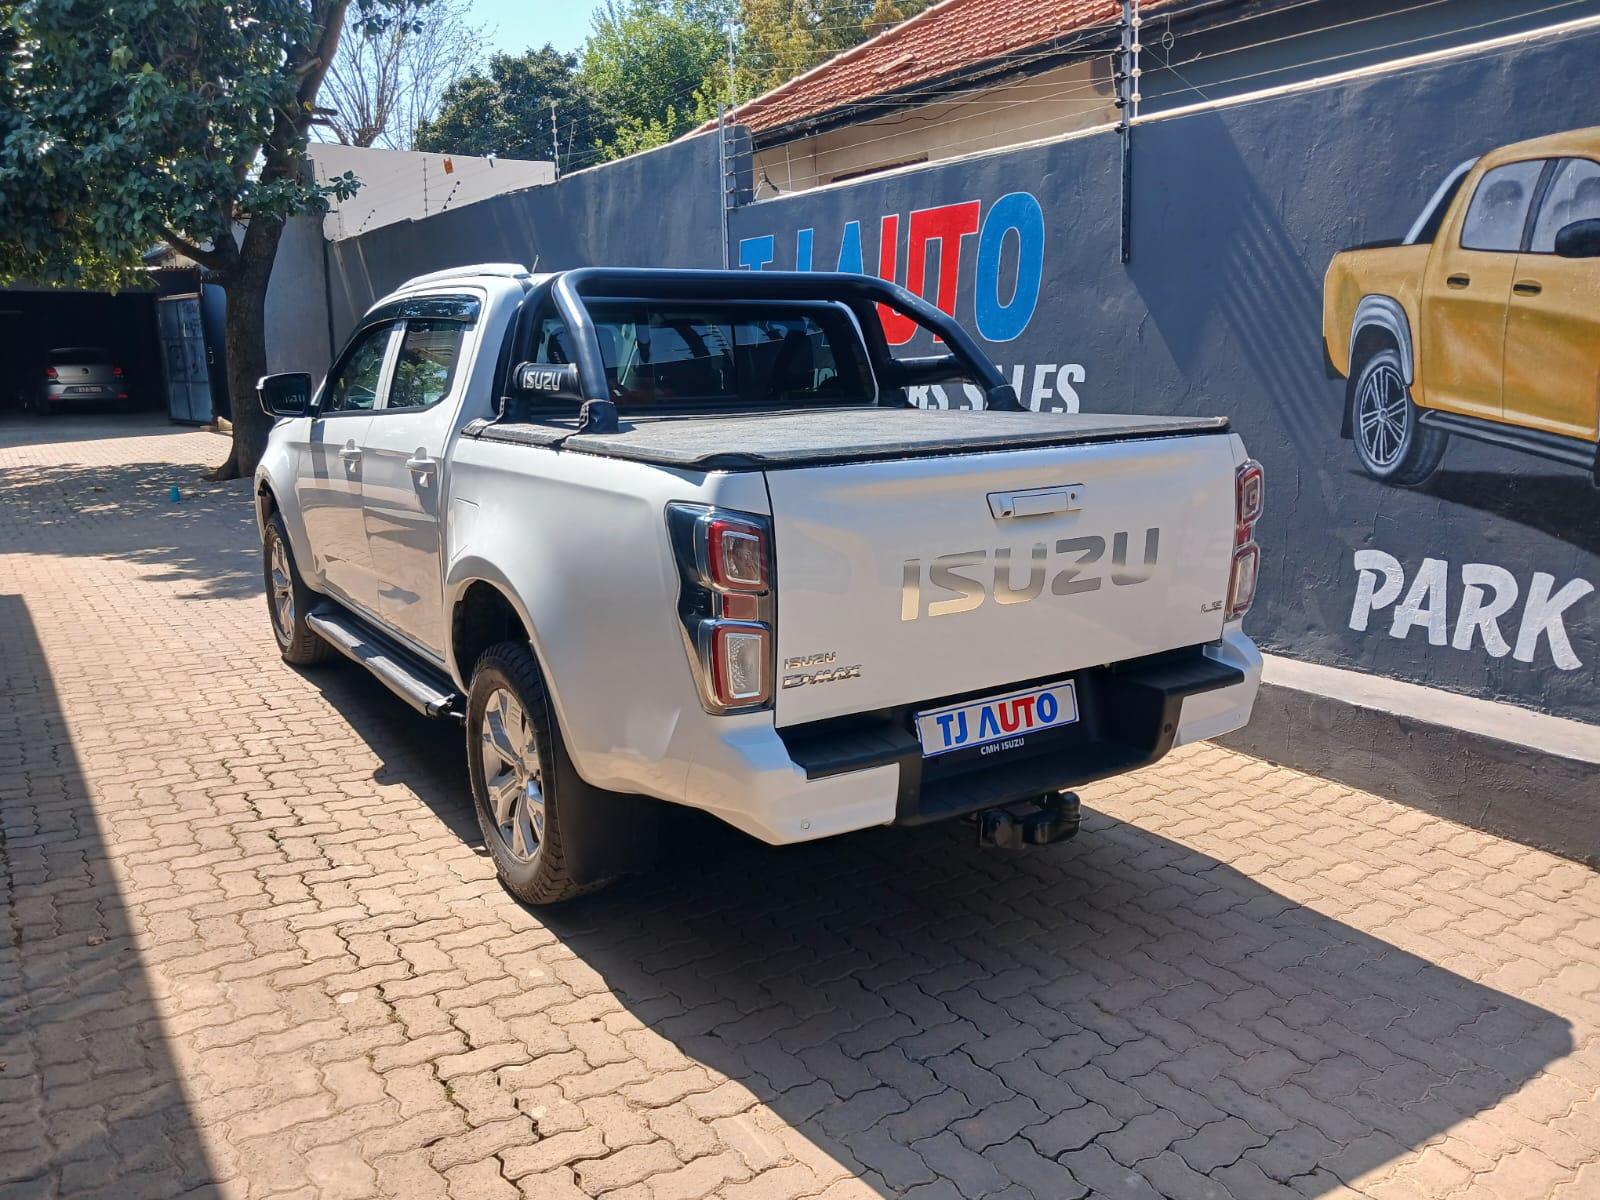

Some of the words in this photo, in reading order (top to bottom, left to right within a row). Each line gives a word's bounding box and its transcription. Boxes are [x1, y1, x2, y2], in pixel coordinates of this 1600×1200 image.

[523, 370, 561, 391] ISUZU
[901, 527, 1160, 621] ISUZU
[1349, 549, 1595, 671] PARK
[784, 651, 837, 671] ISUZU
[936, 711, 968, 747] TJ
[979, 692, 1058, 738] AUTO
[980, 743, 1000, 755] CMH
[1001, 737, 1025, 751] ISUZU
